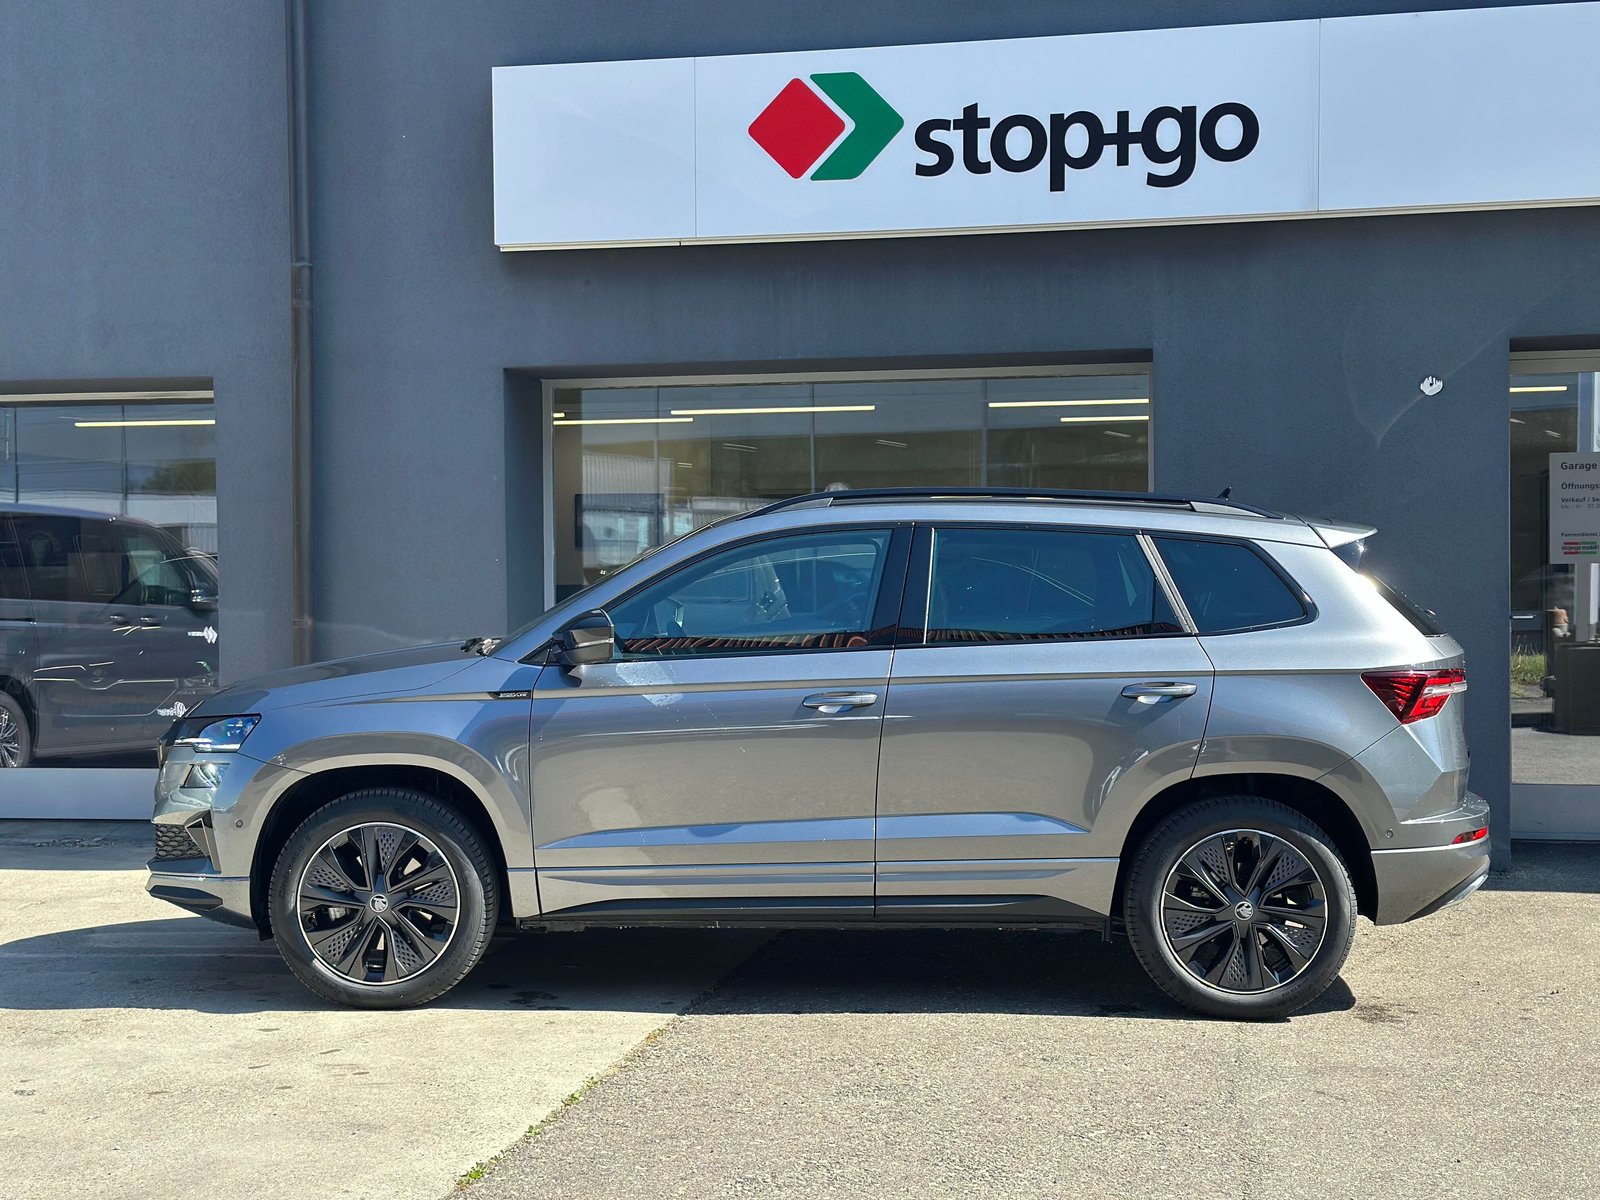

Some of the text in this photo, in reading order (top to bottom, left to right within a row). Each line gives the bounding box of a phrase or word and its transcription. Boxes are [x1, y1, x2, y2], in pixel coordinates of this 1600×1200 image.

[914, 102, 1260, 192] stop+go
[1560, 462, 1598, 471] Garage
[1561, 482, 1600, 490] Öffnungs
